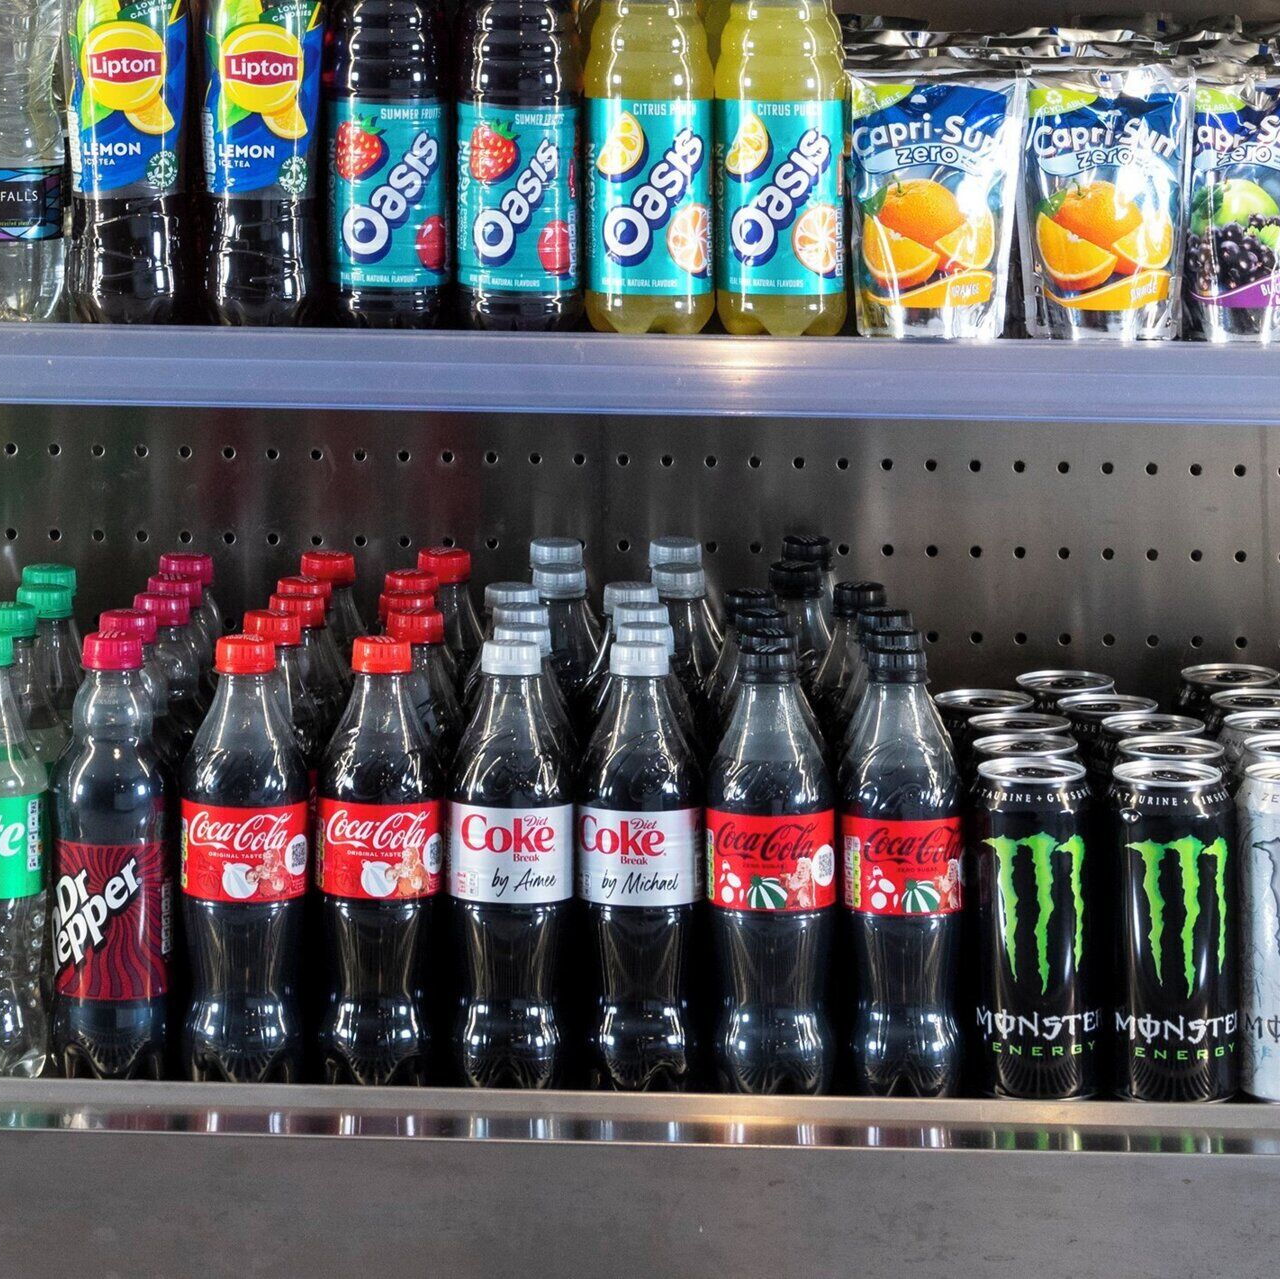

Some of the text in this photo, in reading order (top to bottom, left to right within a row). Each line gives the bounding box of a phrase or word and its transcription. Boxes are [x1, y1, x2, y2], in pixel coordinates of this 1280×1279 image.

[92, 58, 156, 76] Lipton
[231, 59, 293, 79] Lipton
[380, 108, 420, 120] SUMMER
[633, 104, 667, 115] CITRUS
[83, 142, 141, 156] LEMON
[896, 144, 958, 165] zero
[0, 190, 38, 201] FALLS
[343, 132, 438, 255] Oasis
[603, 127, 703, 257] Oasis
[731, 128, 829, 257] Oasis
[981, 790, 1031, 803] TAURINE
[189, 811, 293, 850] Coca-Cola
[327, 810, 430, 849] Coca-Cola
[524, 815, 548, 826] Diet
[461, 814, 554, 853] Coke
[580, 815, 665, 857] Coke
[713, 822, 816, 861] Coca-Cola
[513, 853, 540, 862] Break
[57, 869, 89, 915] Dr
[491, 868, 557, 897] by Aimee
[602, 869, 678, 898] by Michael
[993, 1041, 1095, 1056] ENERGY
